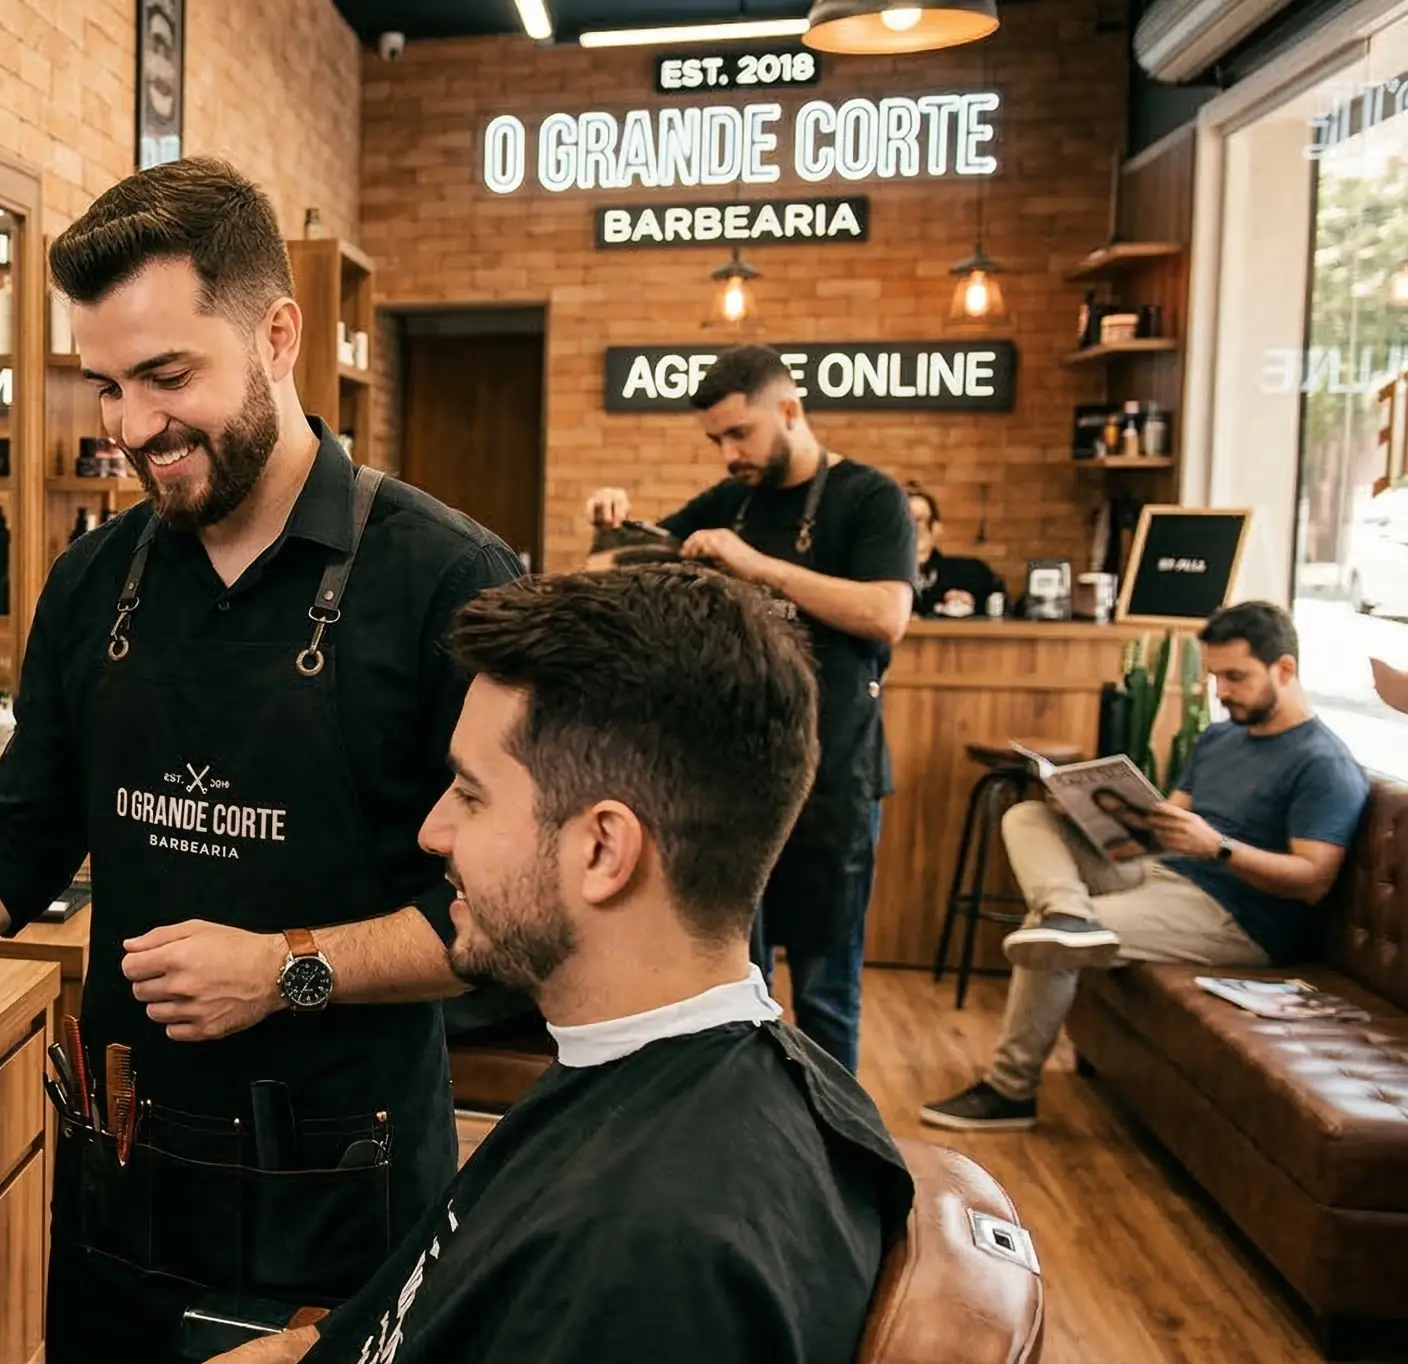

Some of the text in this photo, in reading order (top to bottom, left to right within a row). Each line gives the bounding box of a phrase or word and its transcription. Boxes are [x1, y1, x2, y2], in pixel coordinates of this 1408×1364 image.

[660, 52, 816, 89] EST. 2018
[483, 92, 1000, 194] O GRANDE CORTE
[603, 202, 862, 243] BARBEARIA
[817, 351, 996, 398] ONLINE
[117, 787, 287, 841] O GRANDE CORTE
[149, 834, 240, 860] BARBEARIA
